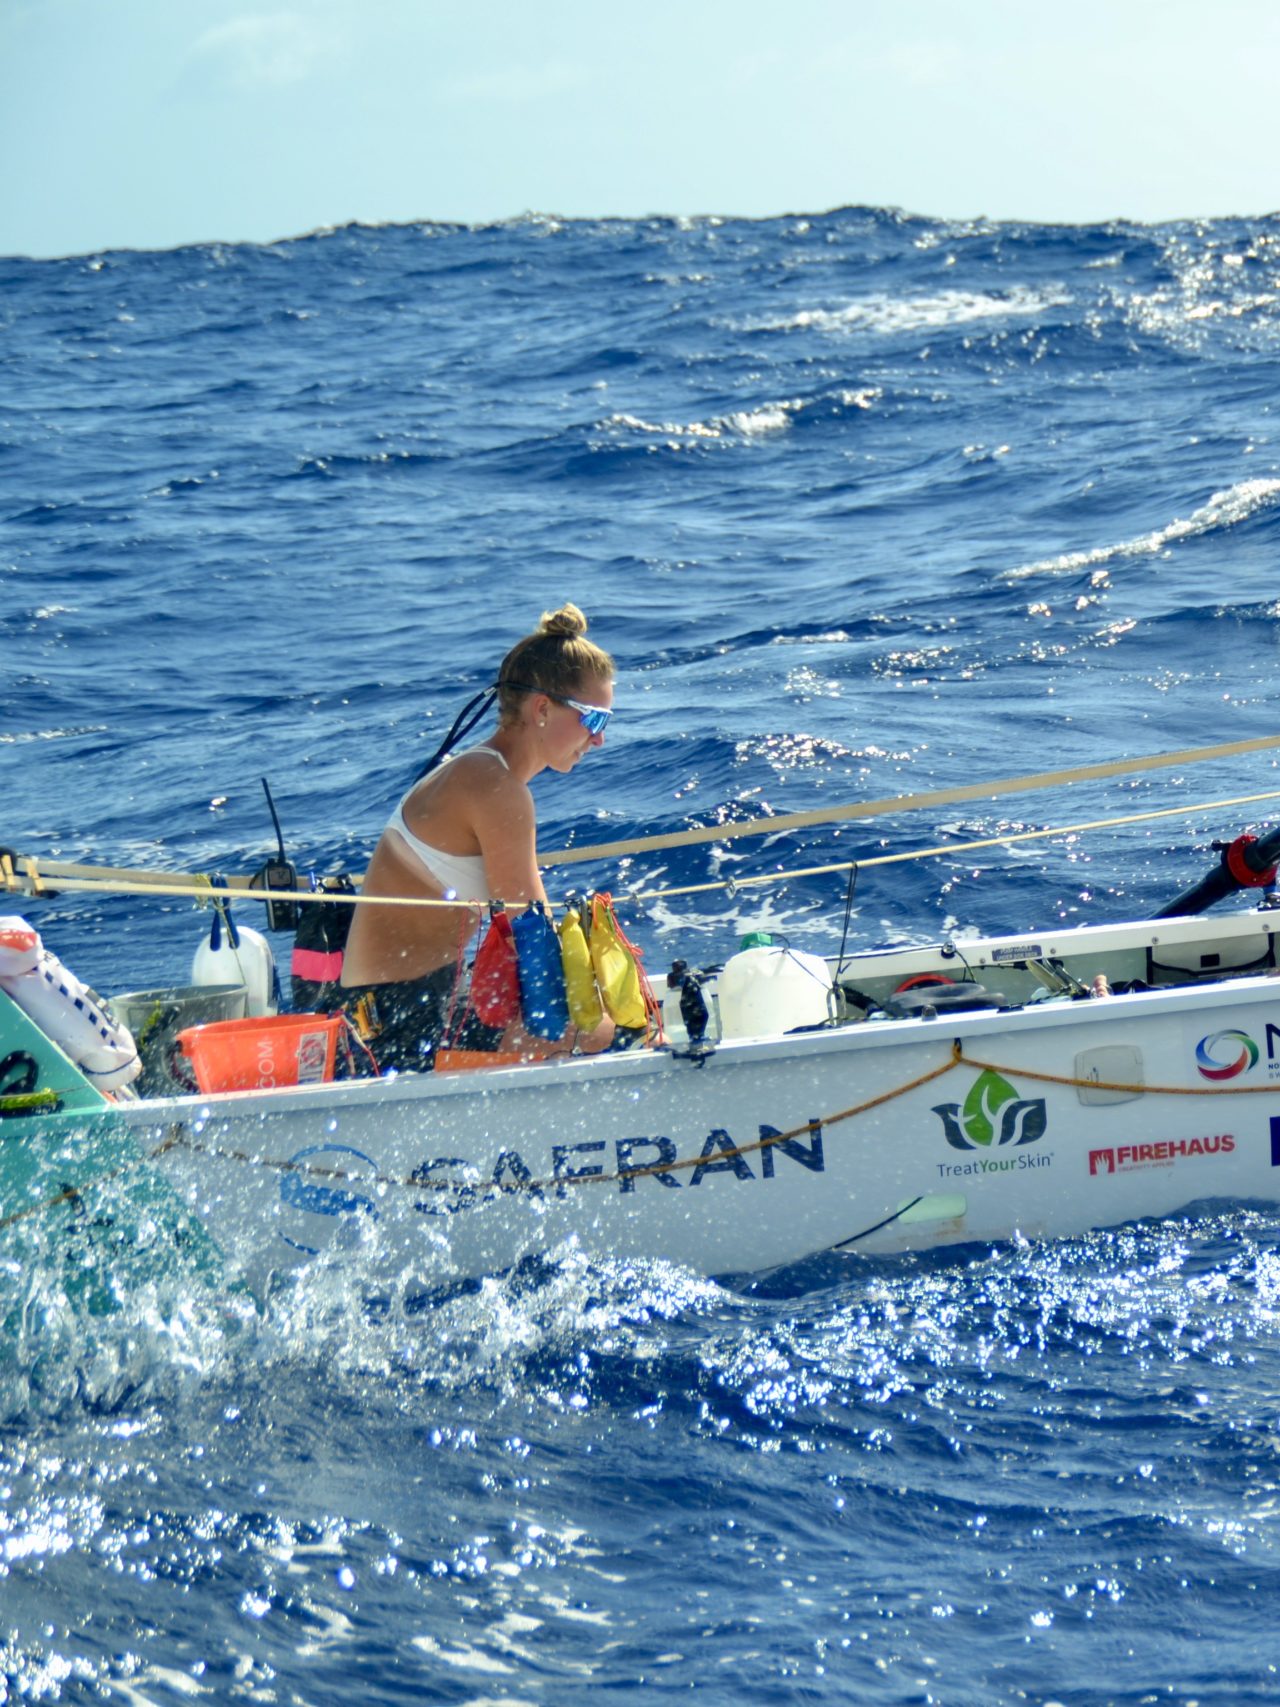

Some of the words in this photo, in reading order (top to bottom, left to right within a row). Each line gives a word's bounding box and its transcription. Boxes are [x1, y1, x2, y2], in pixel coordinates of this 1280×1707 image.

[1117, 1134, 1235, 1164] FIREHAUS
[411, 1118, 824, 1215] SAFRAN
[936, 1153, 1051, 1177] TreatYourSkin
